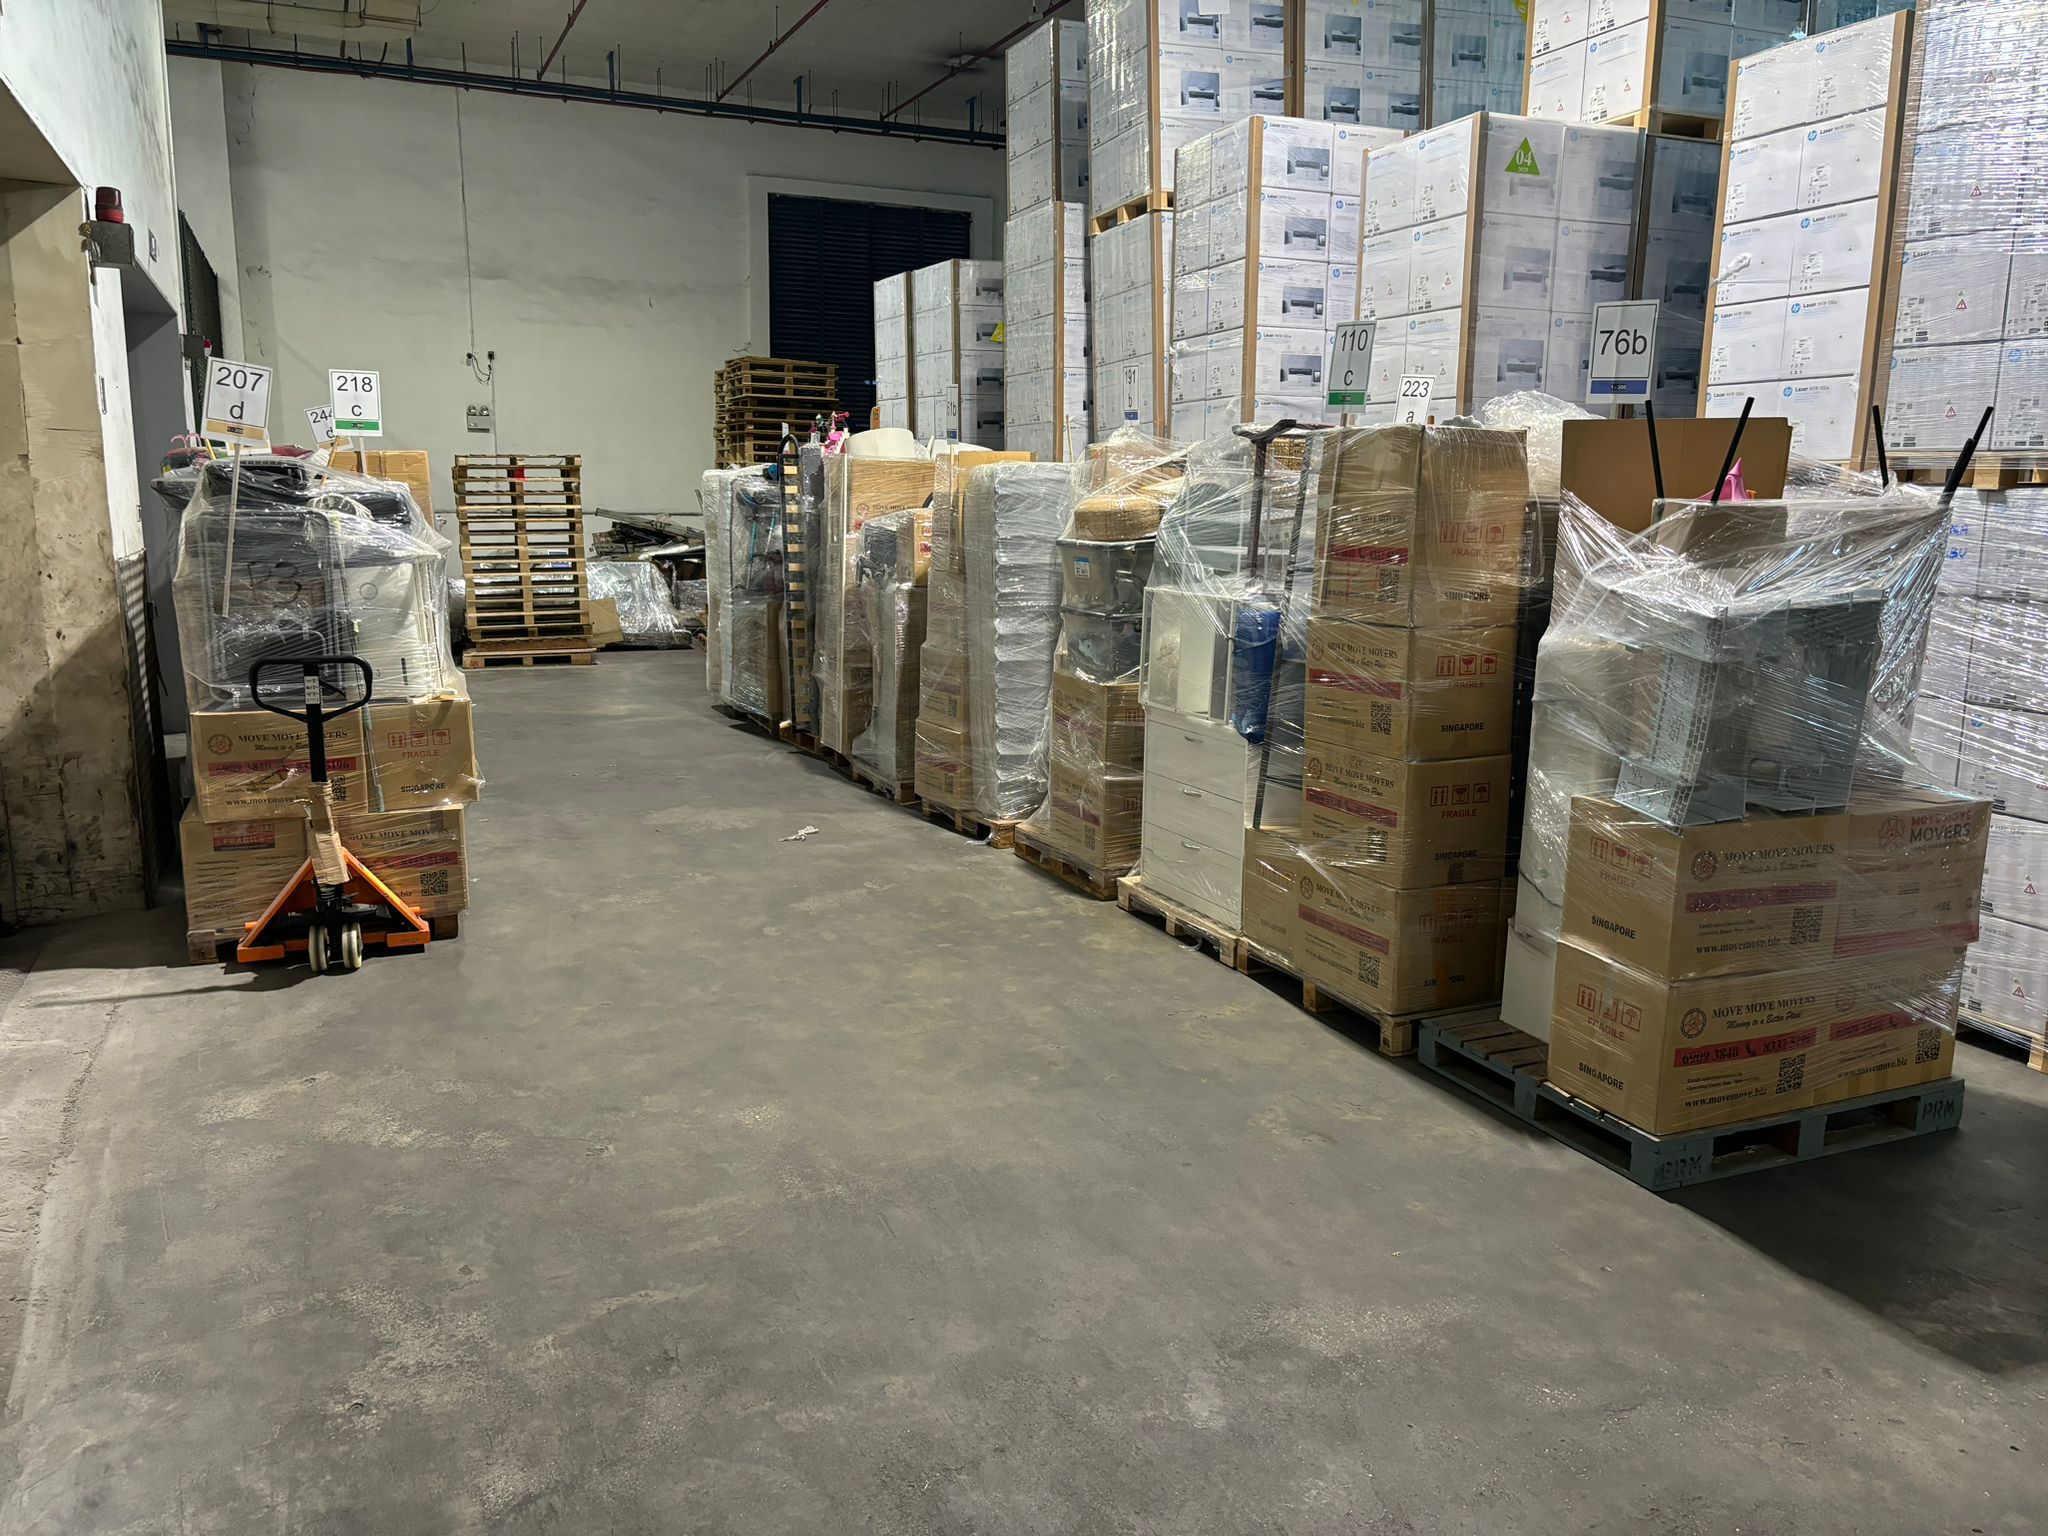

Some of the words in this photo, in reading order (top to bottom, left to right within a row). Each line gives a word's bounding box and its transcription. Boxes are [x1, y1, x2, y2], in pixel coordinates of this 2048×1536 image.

[1516, 150, 1532, 166] 04
[1912, 250, 1930, 258] Laser
[1341, 330, 1369, 352] 110
[1600, 329, 1648, 355] 76b
[1901, 356, 1919, 364] Laser
[216, 366, 264, 392] 207
[336, 376, 373, 393] 218
[1125, 368, 1136, 385] 191
[1402, 380, 1430, 398] 223
[1128, 394, 1133, 408] b
[230, 401, 244, 420] d
[351, 405, 362, 417] c
[1406, 411, 1414, 423] a
[1451, 548, 1490, 558] FRAGILE
[1347, 644, 1367, 654] MOVE
[1368, 648, 1398, 659] MOVERS
[1440, 722, 1485, 733] SINGAPORE
[238, 734, 270, 742] MOVE
[273, 732, 304, 742] MOVE
[402, 750, 440, 759] FRAGILE
[1325, 763, 1344, 775] MOVE
[1345, 768, 1365, 781] MOVE
[1366, 773, 1394, 788] MOVERS
[401, 782, 446, 792] SINGAPORE
[1442, 808, 1478, 819] FRAGILE
[379, 830, 408, 840] MOVE
[1910, 823, 1970, 843] MOVERS
[1434, 850, 1479, 861] SINGAPORE
[1792, 844, 1835, 857] MOVERS
[1600, 869, 1637, 888] FRAGILE
[1316, 885, 1335, 899] MOVE
[1591, 916, 1636, 940] SINGAPORE
[1430, 934, 1465, 945] FRAGILE
[1712, 1005, 1743, 1019] MOVE
[1746, 1001, 1776, 1015] MOVE
[1777, 996, 1817, 1010] MOVERS
[1588, 1018, 1626, 1041] FRAGILE
[1726, 1018, 1751, 1030] Moving
[1752, 1018, 1759, 1026] to
[1766, 1013, 1784, 1025] Better
[1838, 1058, 1909, 1078] www.movemove.biz
[1578, 1062, 1624, 1091] SINGAPORE
[1685, 1088, 1768, 1109] www.movemove.biz
